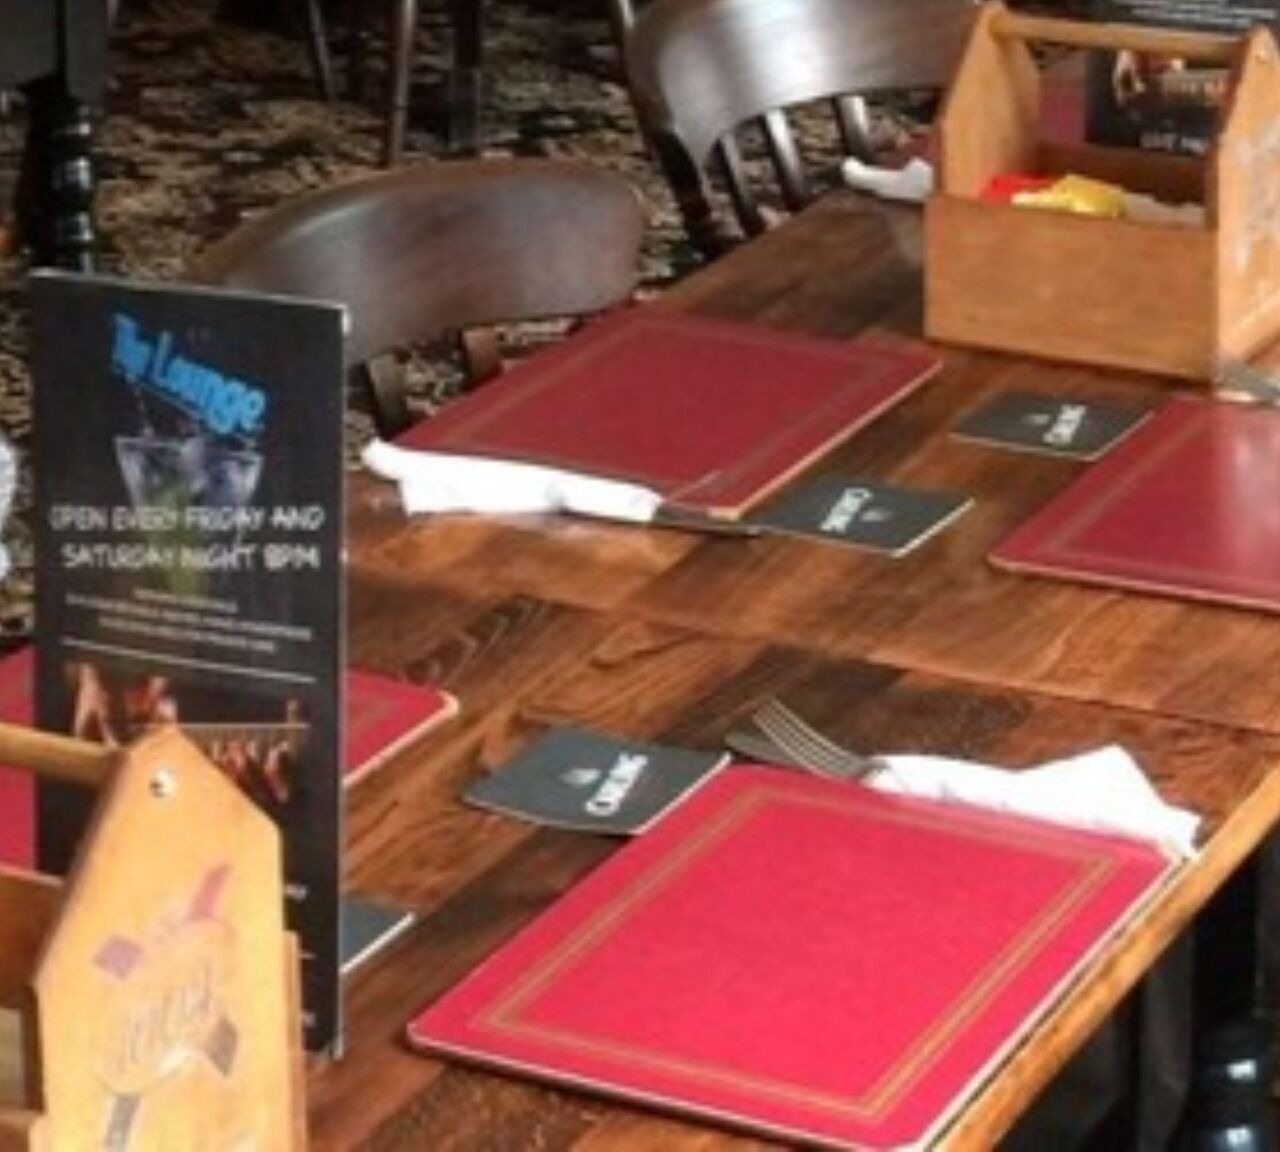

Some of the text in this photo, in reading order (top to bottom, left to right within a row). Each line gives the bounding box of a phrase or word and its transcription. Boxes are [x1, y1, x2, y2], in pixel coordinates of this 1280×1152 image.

[152, 330, 266, 433] Lounge
[48, 505, 325, 532] OPEN EVERY FRIDAY AND
[61, 543, 320, 571] SATURDAY NIGHT 8PM
